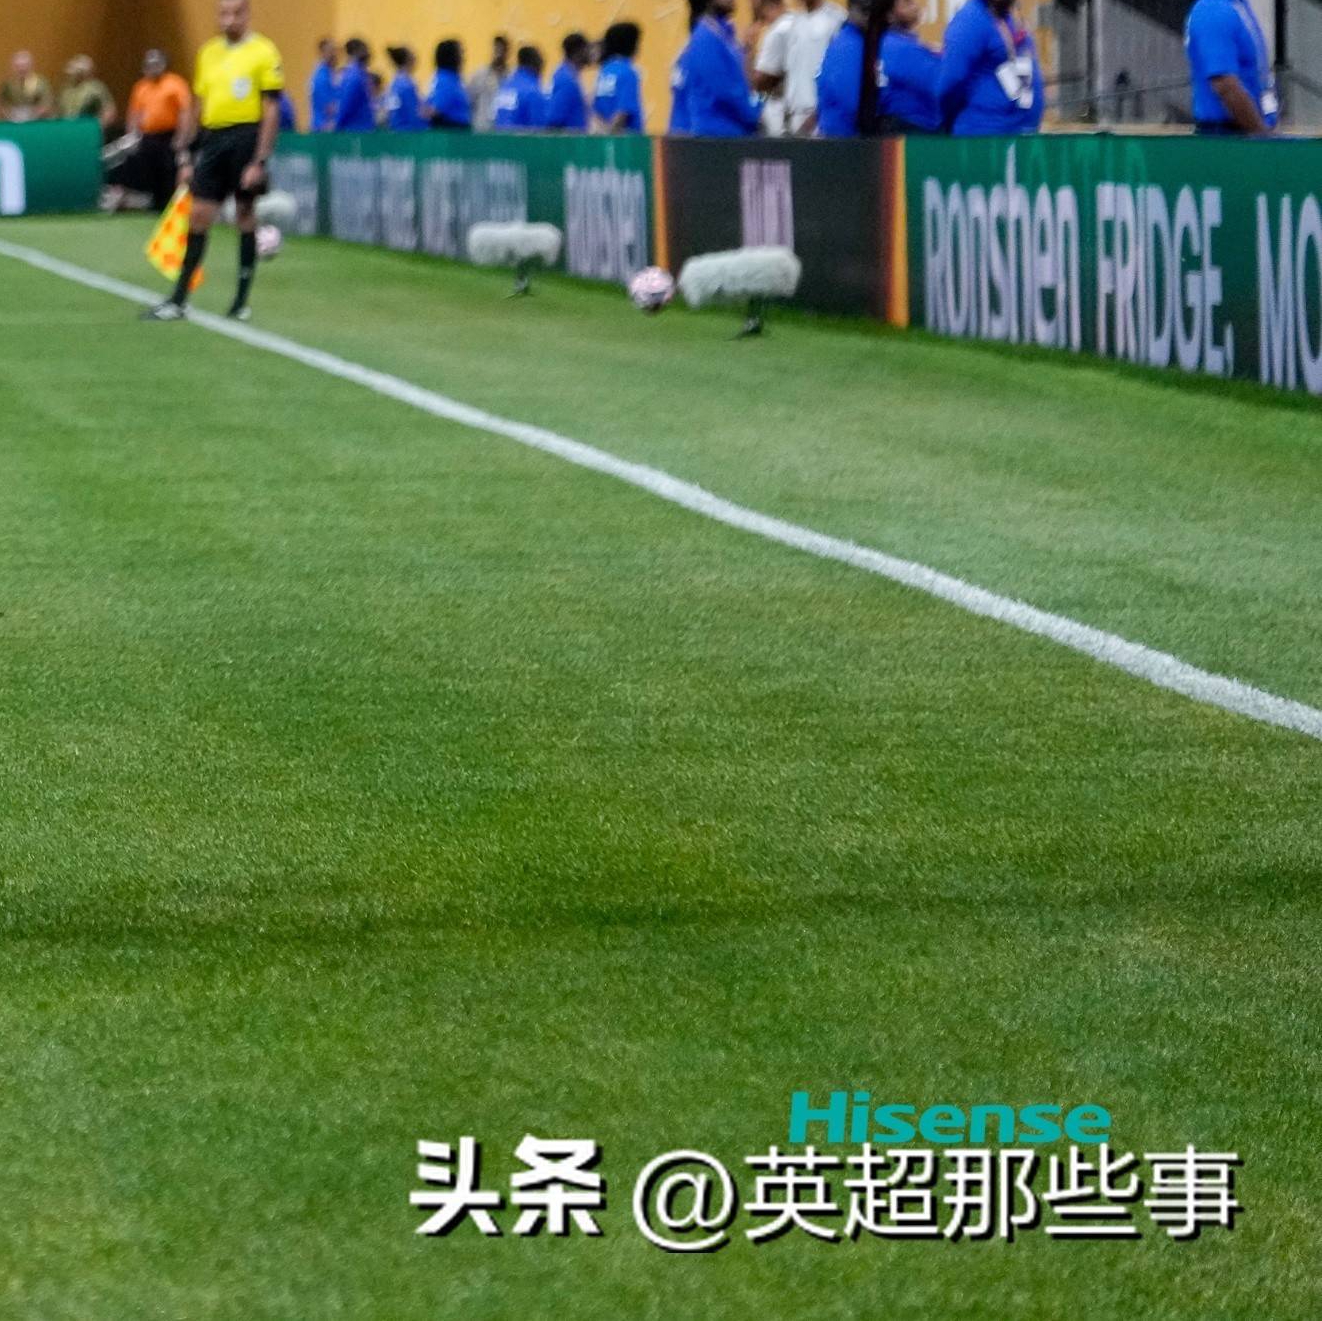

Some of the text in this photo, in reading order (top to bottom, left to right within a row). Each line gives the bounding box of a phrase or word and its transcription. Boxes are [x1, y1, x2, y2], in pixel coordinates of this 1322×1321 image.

[923, 142, 1081, 353] Ronshen
[1095, 181, 1234, 379] FRIDGE.
[1256, 191, 1322, 395] MO
